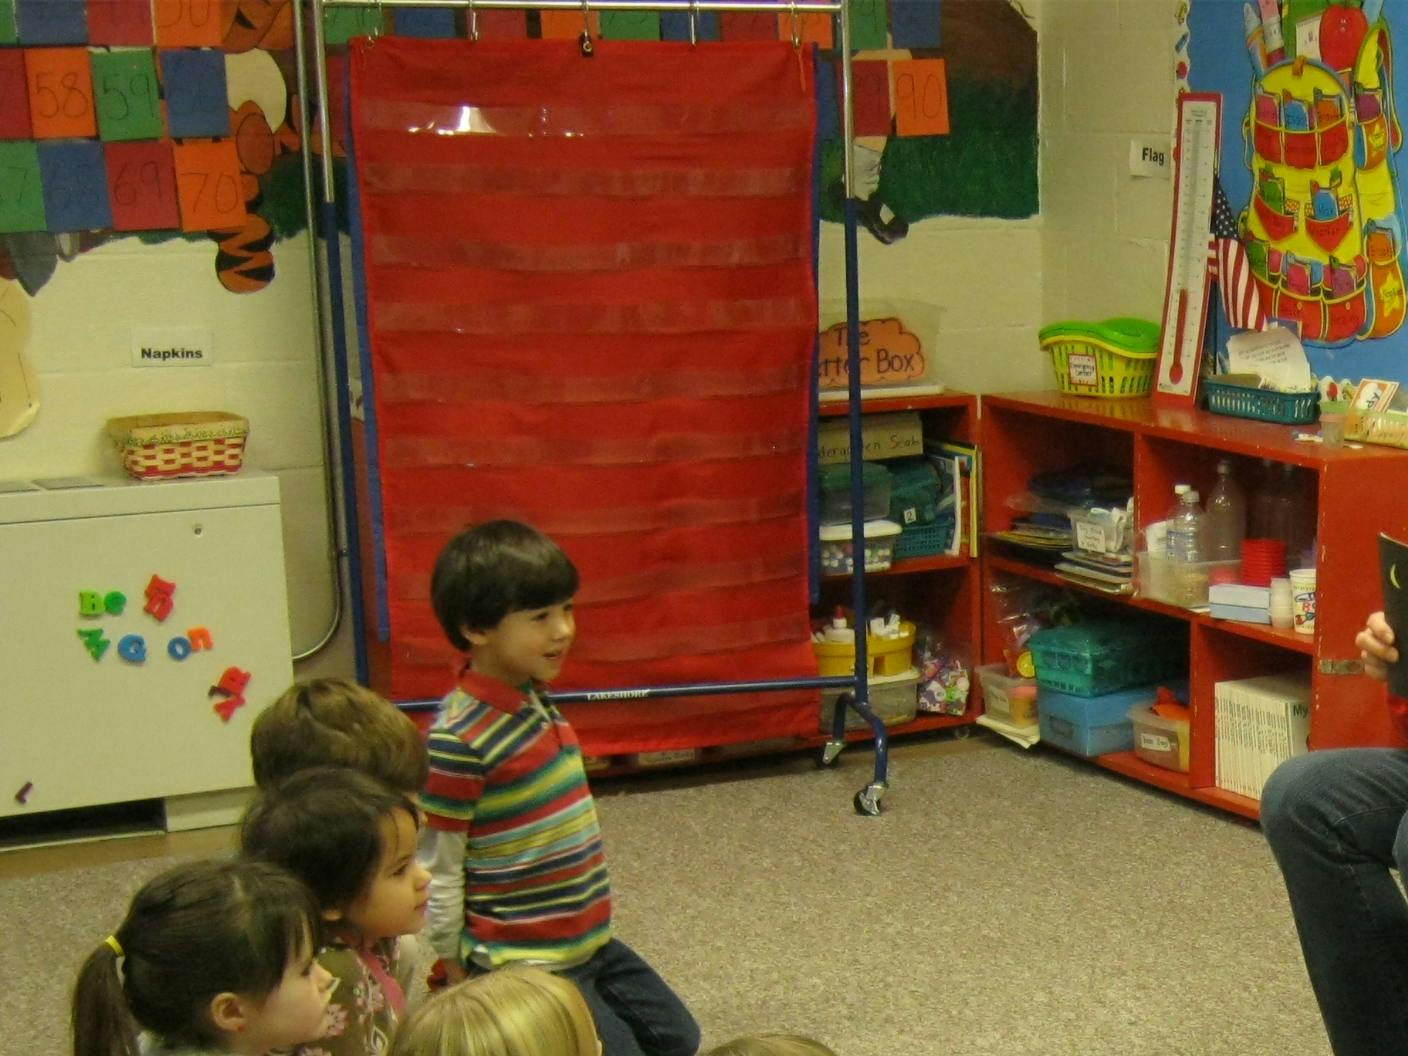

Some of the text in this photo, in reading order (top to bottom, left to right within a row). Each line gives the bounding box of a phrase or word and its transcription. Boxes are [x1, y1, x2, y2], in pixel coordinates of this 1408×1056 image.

[34, 71, 89, 118] 58
[102, 73, 157, 121] 59
[896, 73, 943, 121] 90
[1141, 147, 1165, 165] Flag
[113, 160, 162, 206] 69
[180, 171, 238, 214] 70
[834, 326, 871, 347] Te
[140, 346, 203, 361] Napkins
[877, 348, 914, 373] Box
[587, 688, 650, 701] LAKESHORE
